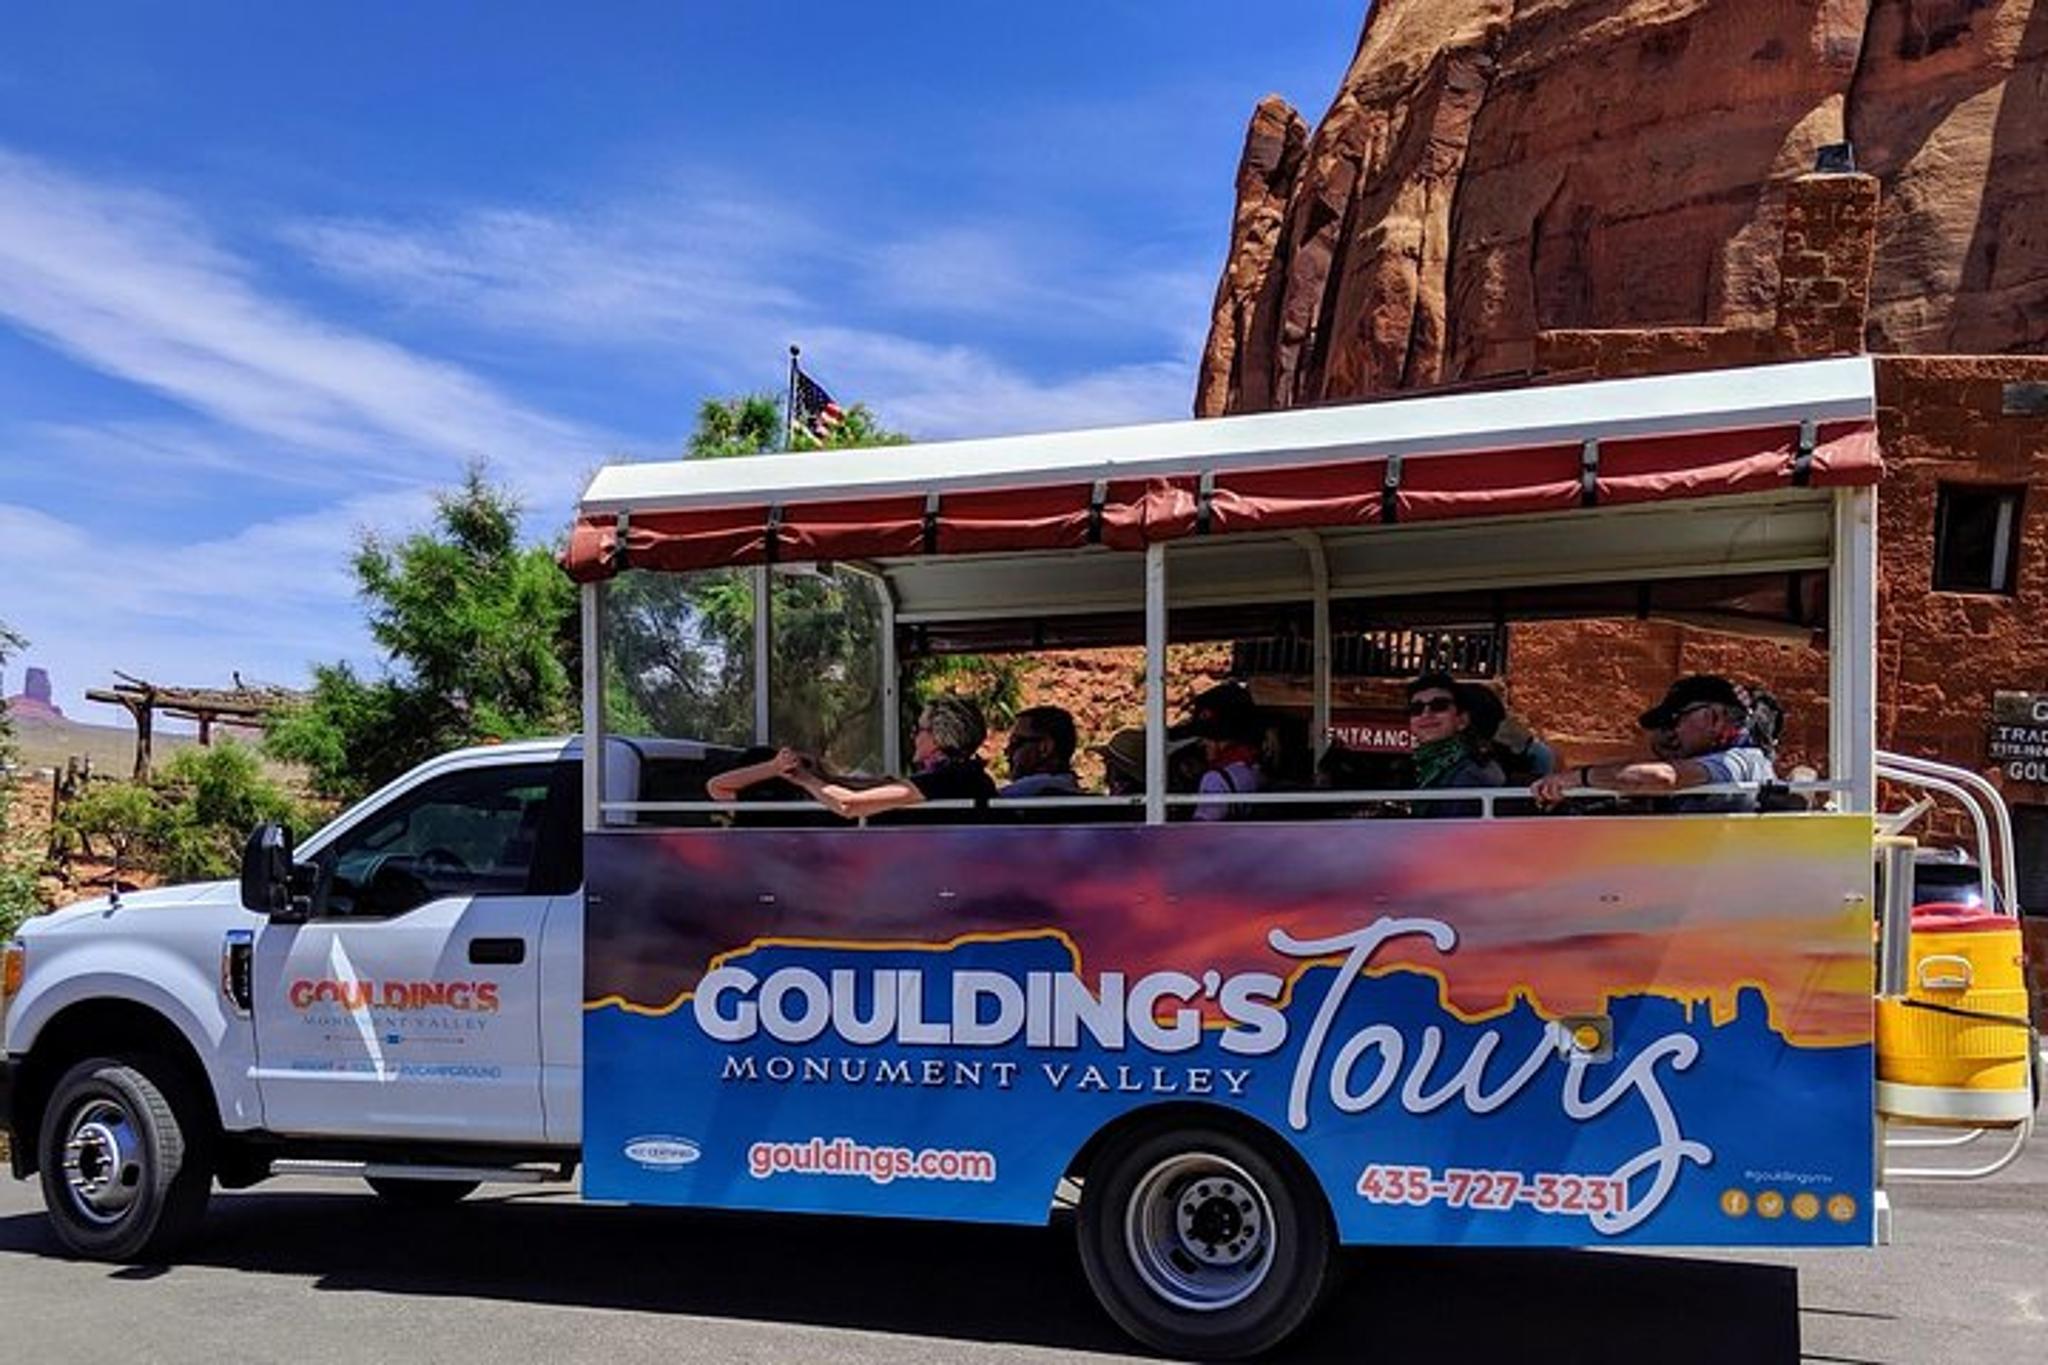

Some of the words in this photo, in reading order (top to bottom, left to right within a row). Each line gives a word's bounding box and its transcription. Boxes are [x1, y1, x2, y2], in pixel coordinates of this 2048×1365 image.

[1327, 727, 1420, 749] ENTRANCE
[289, 979, 502, 1014] GOULDING'S
[693, 966, 1289, 1055] GOULDING'S
[721, 1056, 1019, 1088] MONUMENT
[1043, 1065, 1253, 1096] VALLEY
[748, 1136, 997, 1184] gouldings.com
[1357, 1164, 1630, 1214] 435-727-3231
